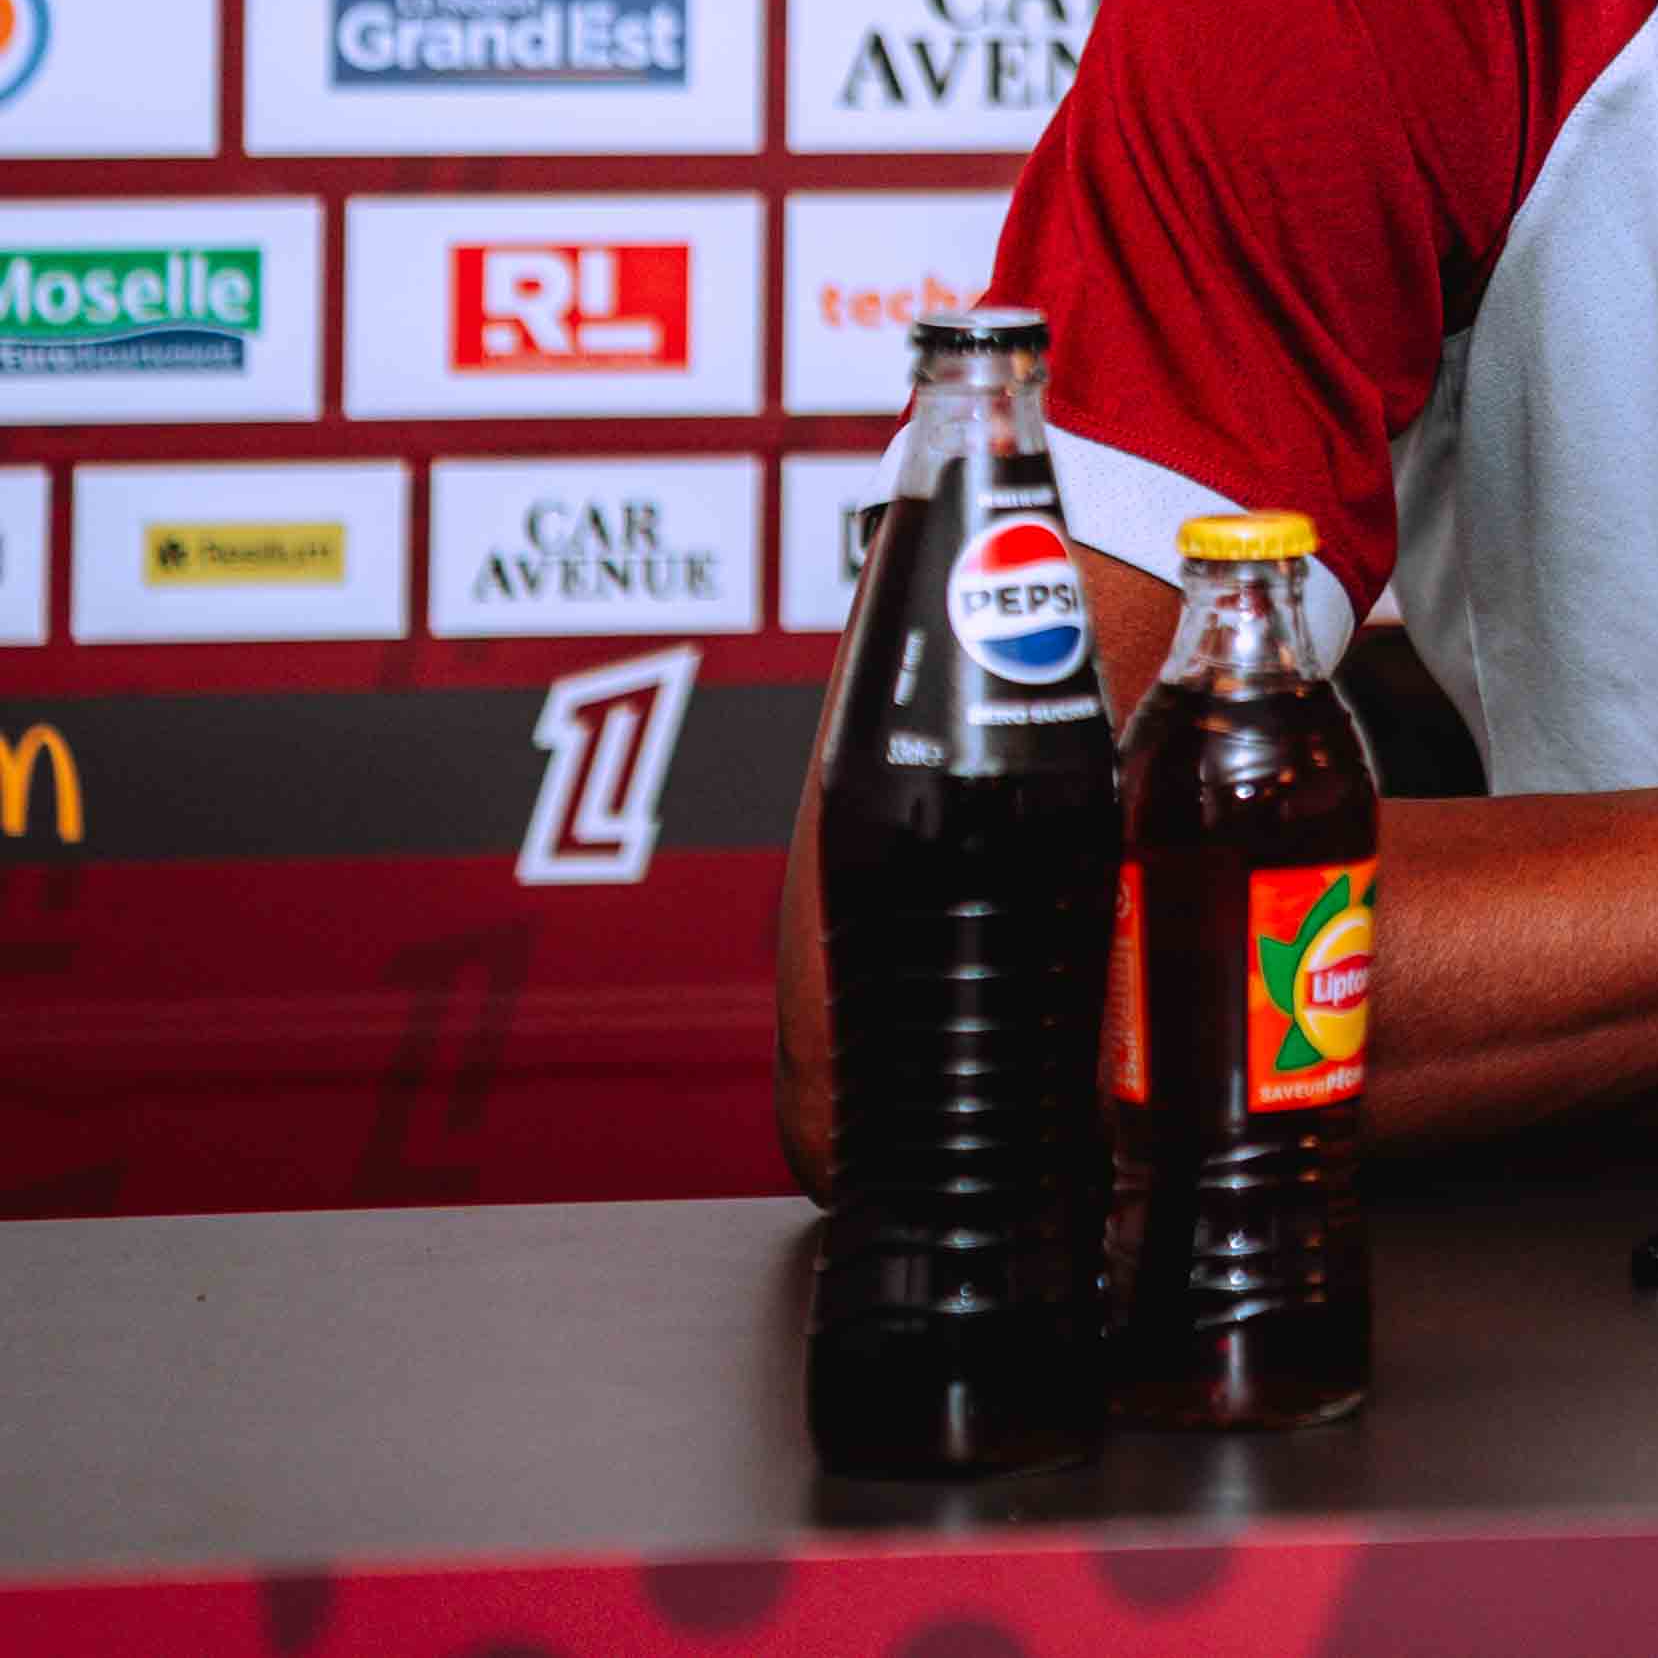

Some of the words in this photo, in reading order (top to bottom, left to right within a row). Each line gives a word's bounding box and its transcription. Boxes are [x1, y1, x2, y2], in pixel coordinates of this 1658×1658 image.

[483, 250, 663, 357] RL
[525, 501, 660, 548] CAR
[475, 552, 719, 601] AVENUE
